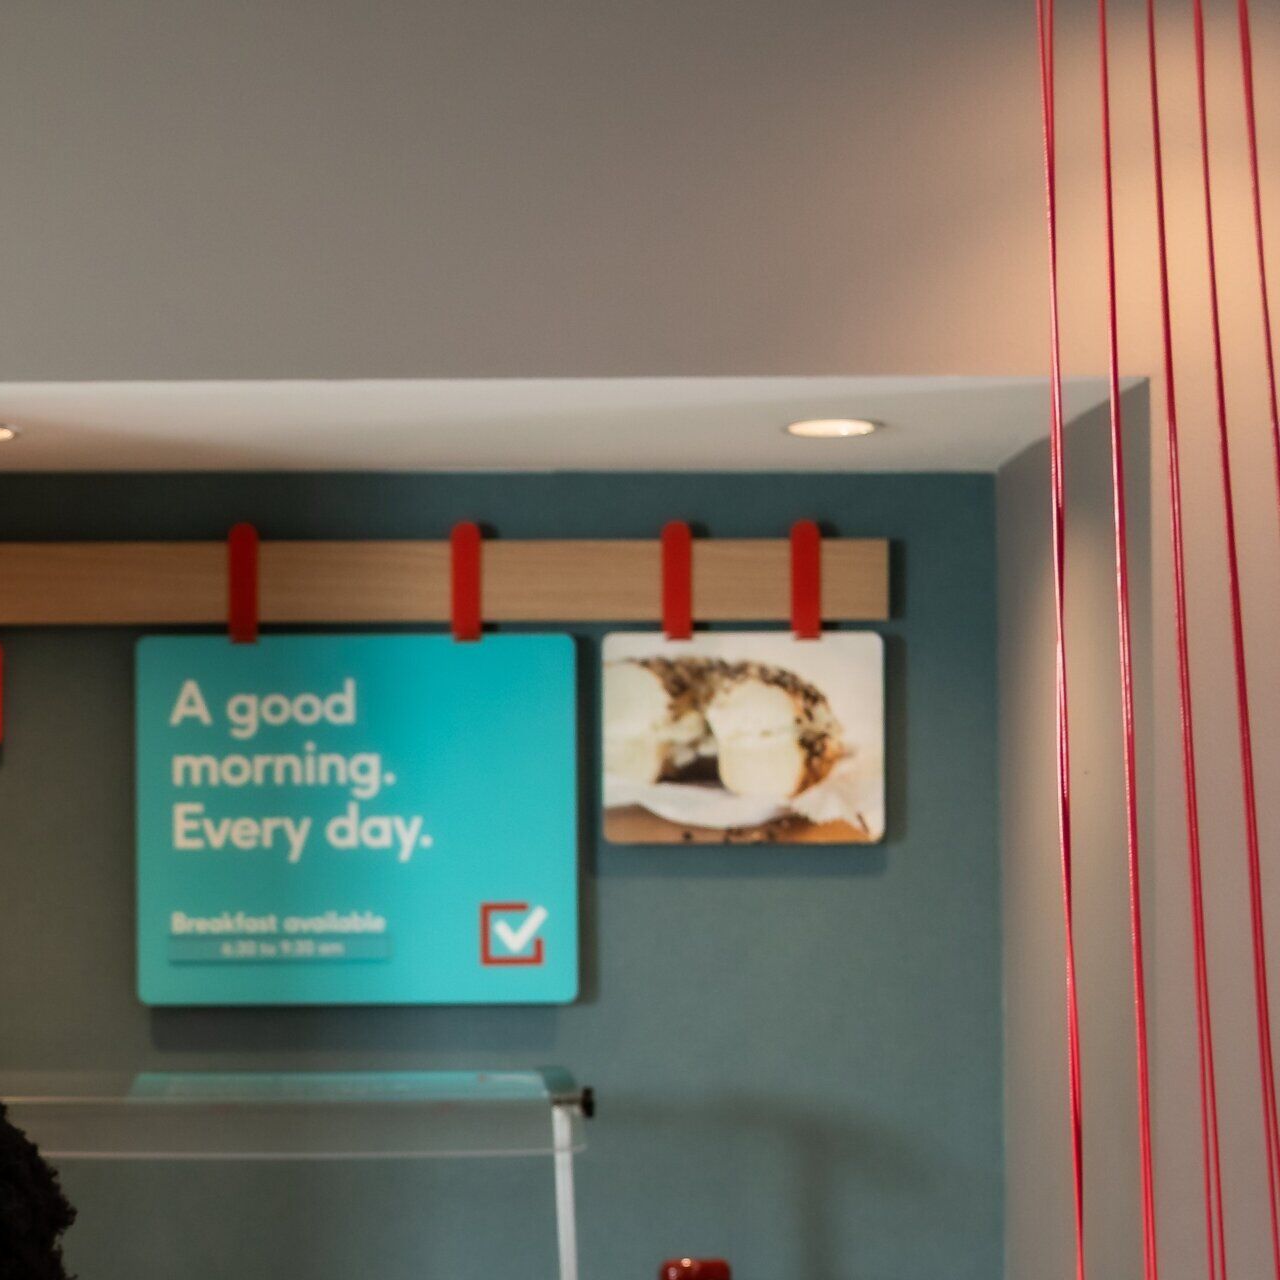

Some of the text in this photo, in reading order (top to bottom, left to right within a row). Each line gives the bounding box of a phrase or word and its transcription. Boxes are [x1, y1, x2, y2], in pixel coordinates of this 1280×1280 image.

[170, 676, 356, 740] A good
[171, 740, 396, 800] morning.
[172, 800, 433, 863] Every day.
[171, 910, 387, 934] Breakfast available
